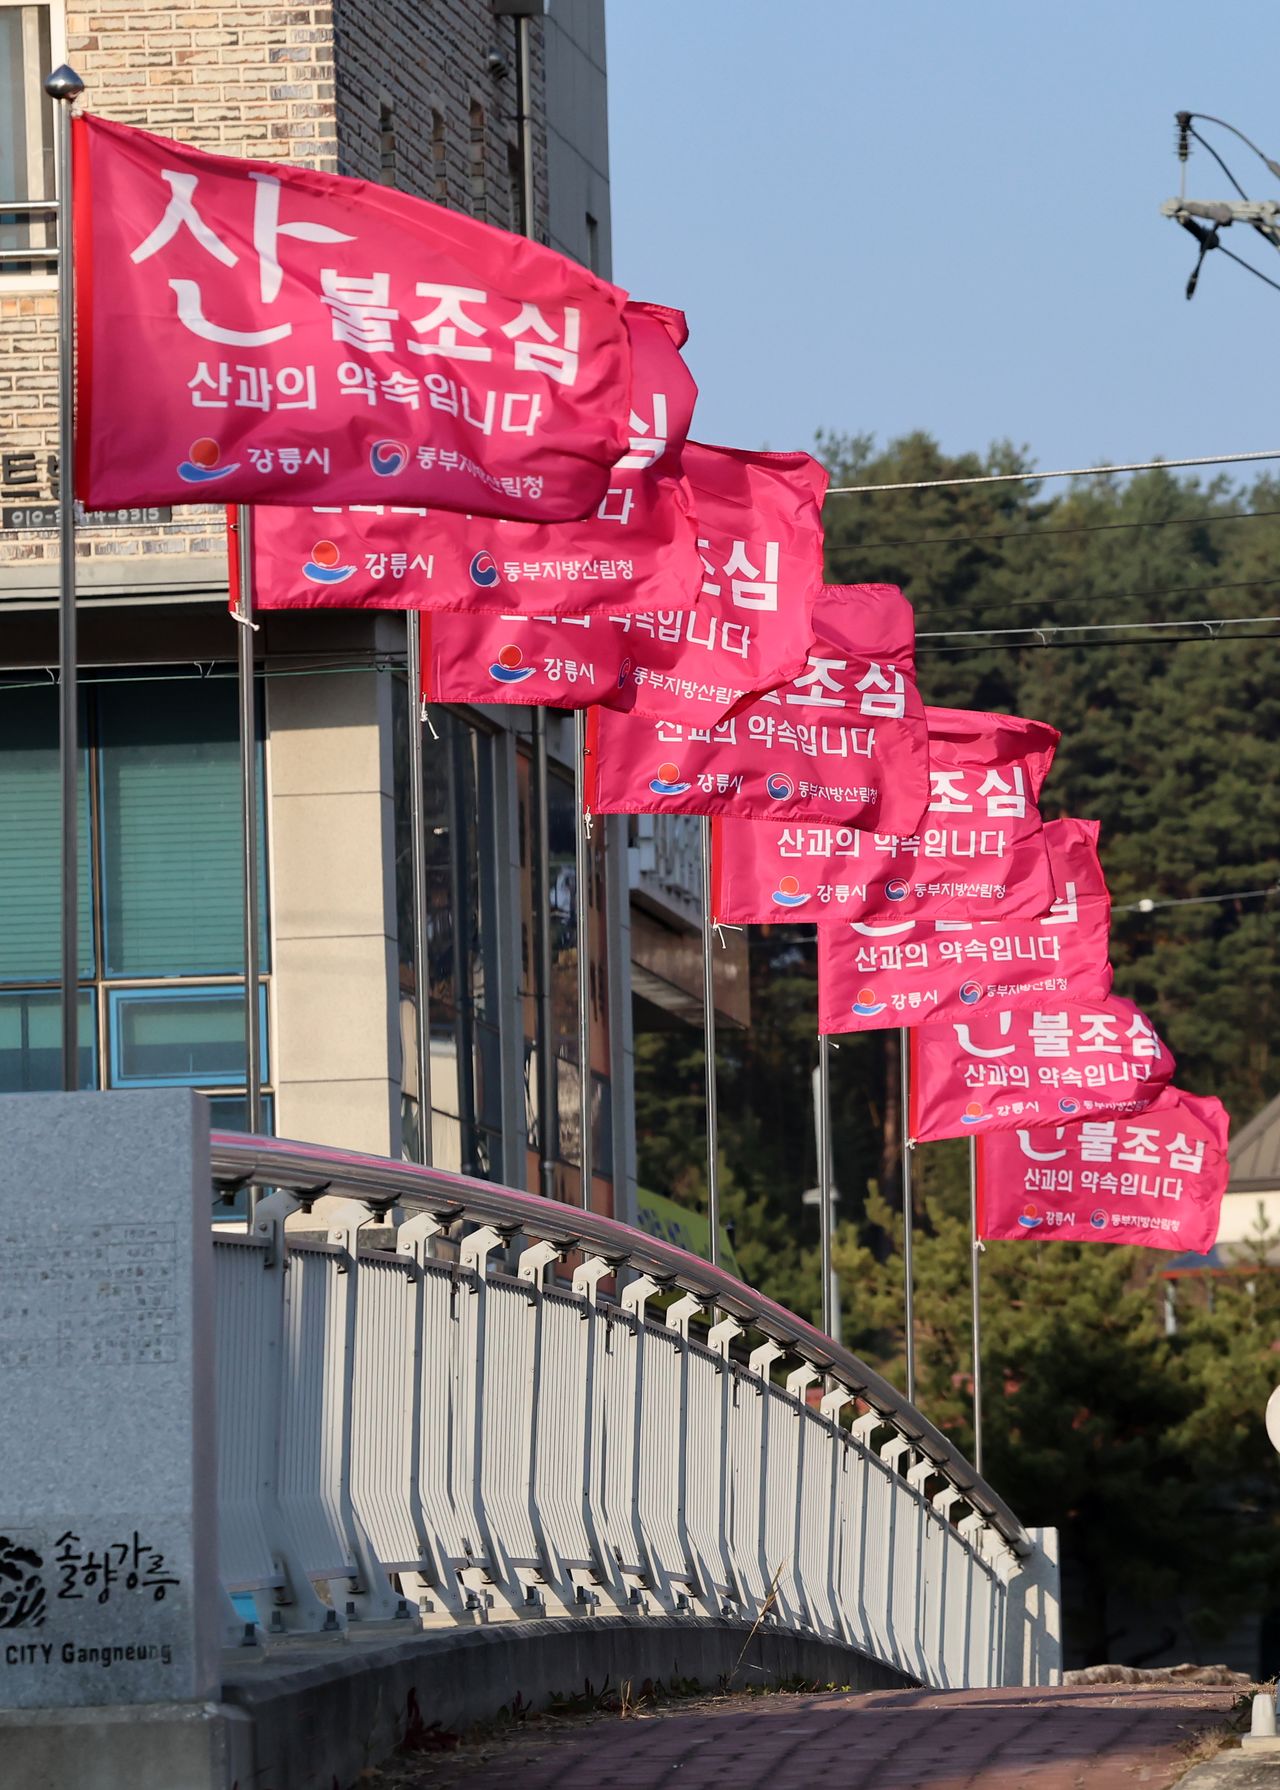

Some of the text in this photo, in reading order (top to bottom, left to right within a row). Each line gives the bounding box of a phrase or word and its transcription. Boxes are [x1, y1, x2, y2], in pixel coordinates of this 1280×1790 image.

[130, 165, 579, 386] 산불조심
[188, 362, 316, 411] 산과의
[337, 361, 543, 436] 약속입니다
[248, 449, 328, 473] 강릉시
[365, 554, 433, 579] 강릉시
[504, 560, 632, 582] 동부지방산림청
[544, 659, 594, 684] 강릉시
[749, 716, 875, 758] 약속입니다
[698, 774, 743, 793] 강릉시
[799, 782, 876, 802] 동부지방산림청
[929, 767, 1025, 818] 조심
[778, 829, 859, 857] 산과의
[817, 884, 866, 903] 강릉시
[915, 883, 1005, 898] 동부지방산림청
[855, 936, 1060, 971] 산과의 약속입니다
[891, 990, 937, 1010] 강릉시
[965, 1062, 1151, 1088] 산과의 약속입니다
[1024, 1169, 1183, 1200] 산과의 약속입니다
[1047, 1212, 1074, 1225] 강릉시
[55, 1530, 180, 1604] 솔향강릉
[6, 1643, 171, 1667] CITY Gangneung
